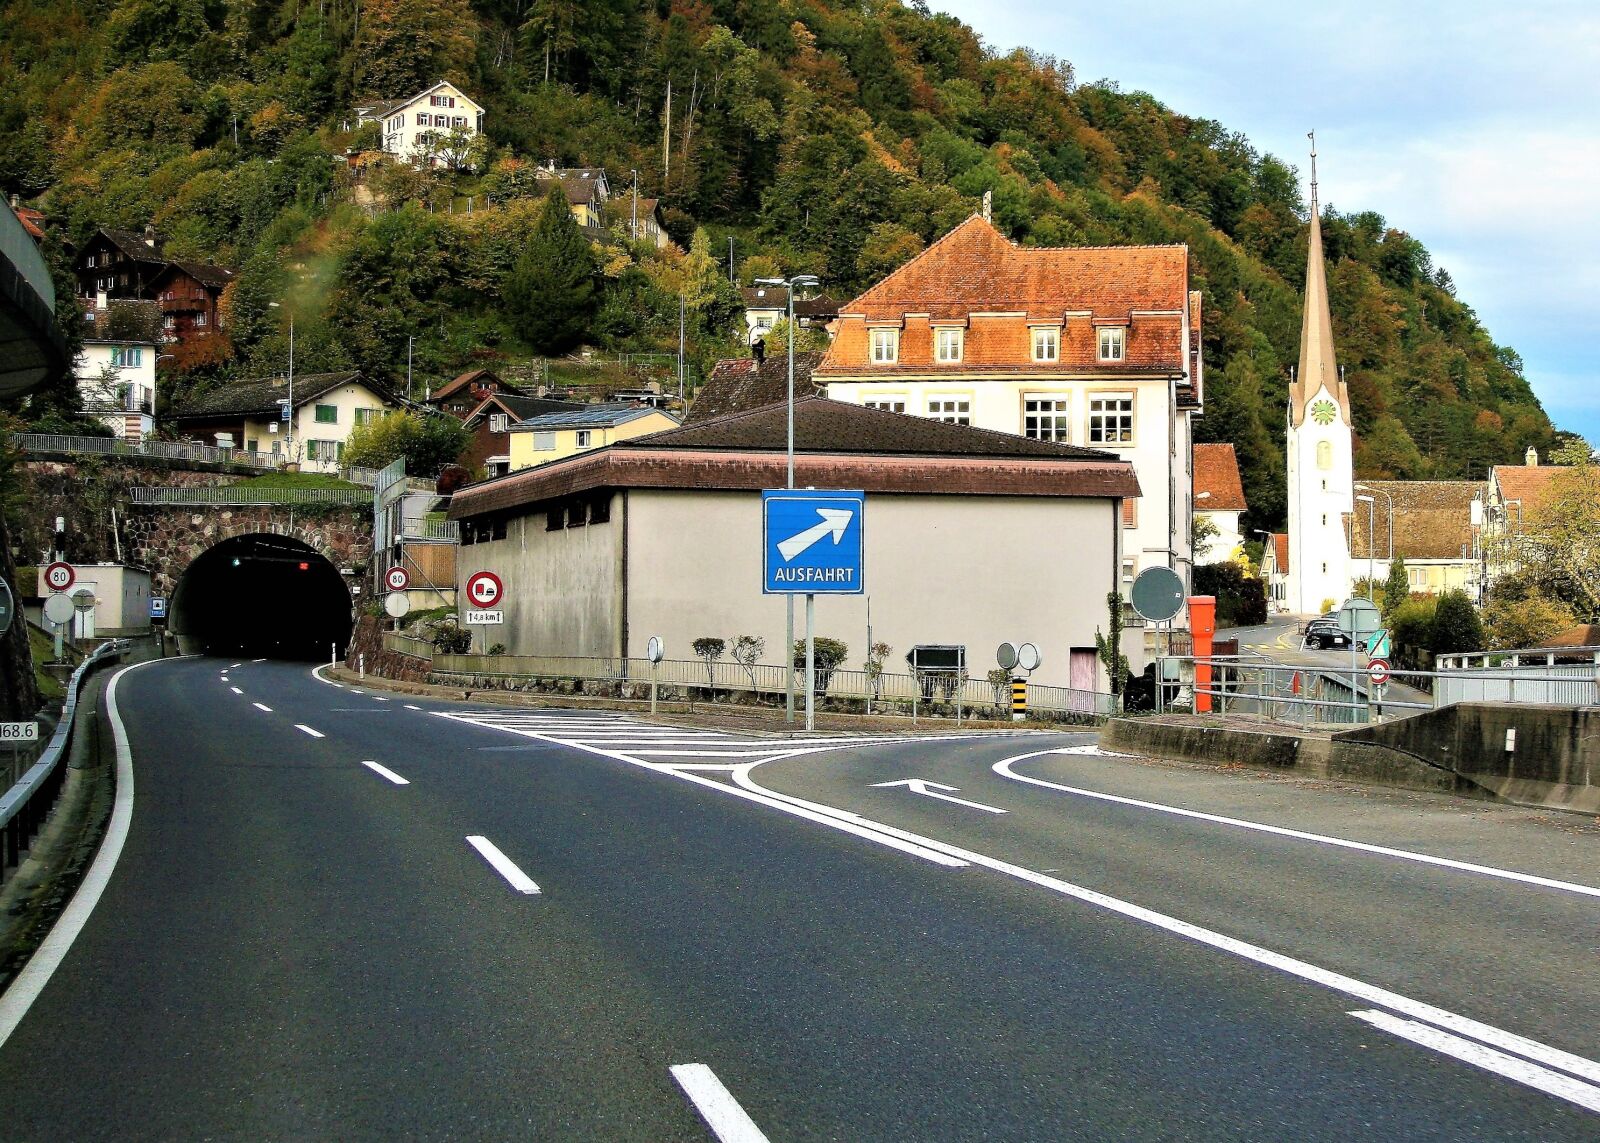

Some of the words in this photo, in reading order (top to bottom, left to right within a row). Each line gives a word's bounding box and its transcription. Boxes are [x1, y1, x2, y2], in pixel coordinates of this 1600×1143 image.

[54, 571, 65, 581] 80
[393, 575, 402, 583] 80
[775, 568, 853, 581] AUSFAHRT
